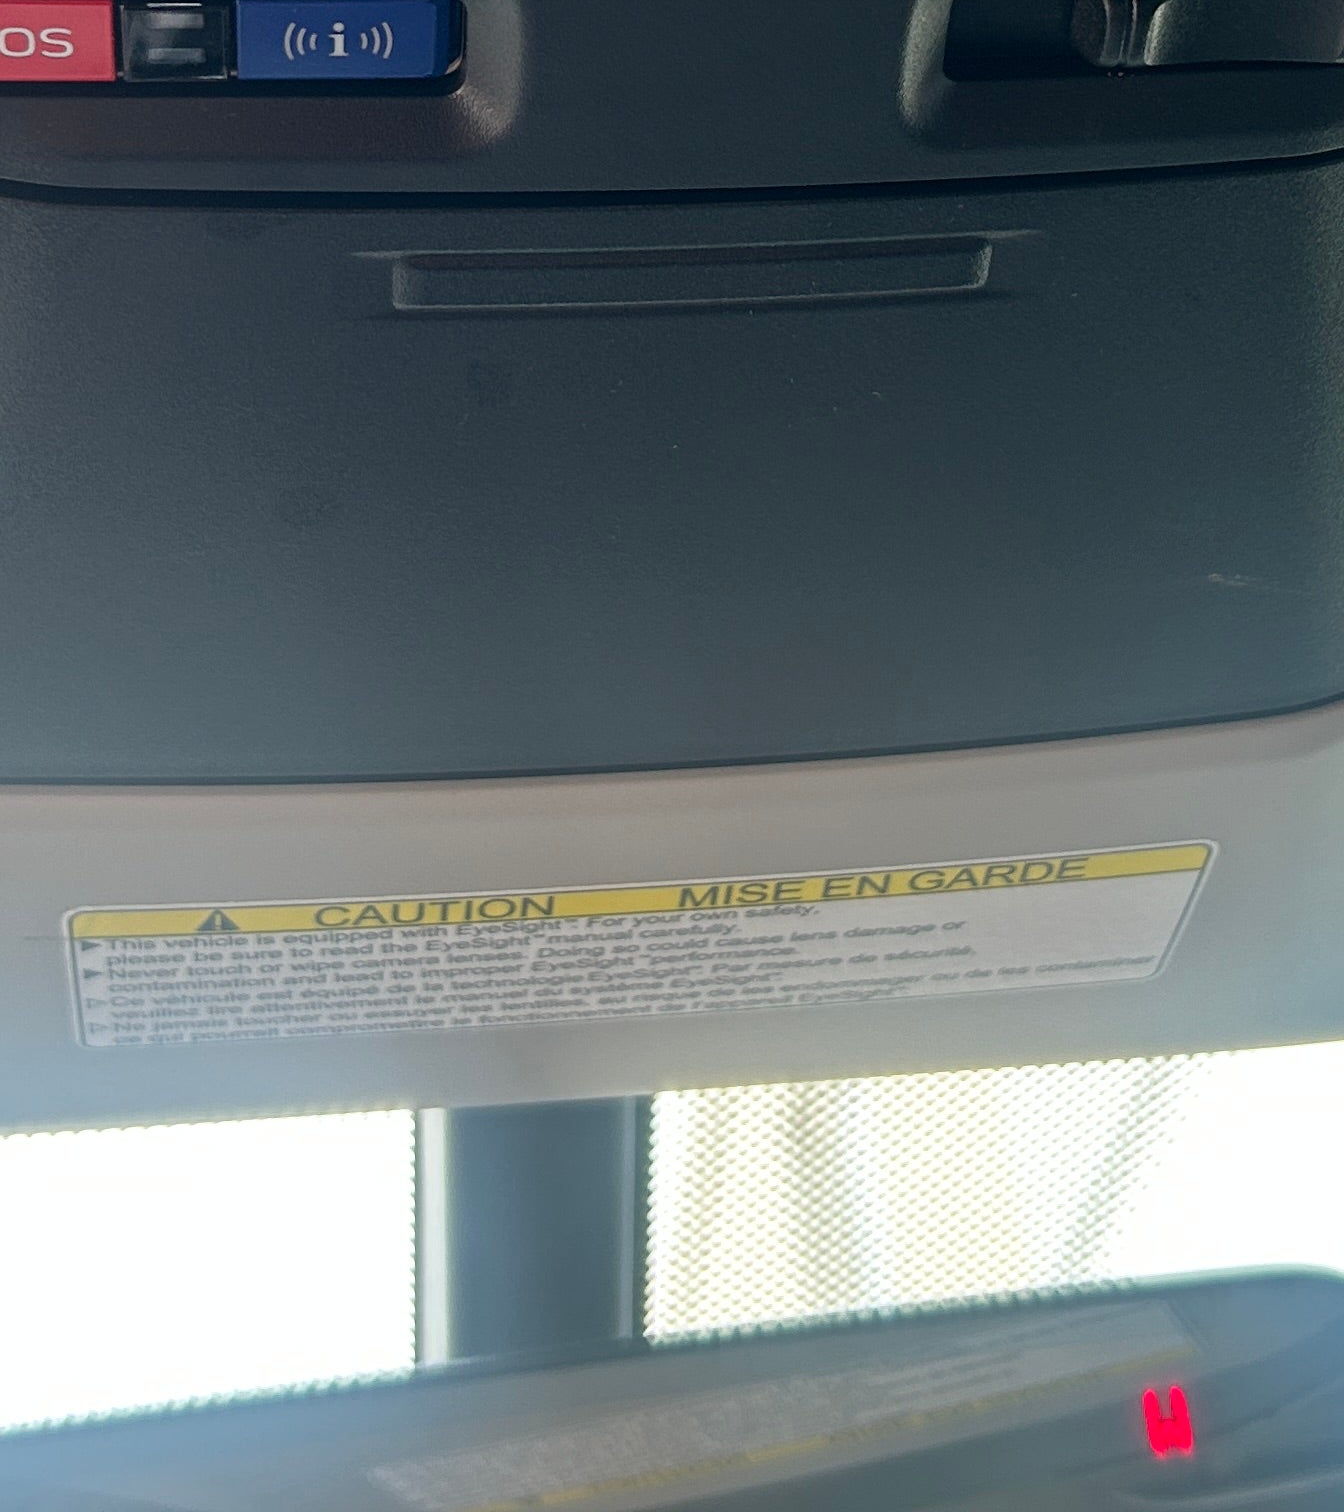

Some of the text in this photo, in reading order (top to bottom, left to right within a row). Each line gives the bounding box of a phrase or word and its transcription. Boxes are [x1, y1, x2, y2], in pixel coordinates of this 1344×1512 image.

[678, 857, 1089, 907] MISE EN GARDE
[105, 936, 155, 950] This
[164, 934, 247, 949] vehicle
[256, 934, 274, 945] is
[283, 928, 392, 946] equipped
[401, 925, 446, 937] with
[586, 914, 626, 926] For
[632, 913, 684, 926] your
[690, 909, 738, 921] own
[744, 903, 820, 918] safety.
[314, 895, 555, 926] CAUTION
[106, 951, 185, 966] please
[194, 949, 222, 961] be
[231, 949, 282, 960] sure
[290, 946, 312, 957] to
[320, 943, 373, 955] read
[380, 941, 417, 953] the
[546, 929, 632, 943] manual
[639, 923, 741, 938] carefully.
[108, 964, 178, 980] Never
[186, 963, 250, 976] touch
[259, 963, 282, 972] or
[290, 959, 344, 972] wipe
[351, 955, 439, 967] camera
[537, 944, 605, 959] Doing
[611, 943, 639, 953] so
[646, 938, 708, 950] could
[715, 935, 783, 946] cause
[790, 929, 837, 941] lens
[843, 923, 936, 938] damage
[941, 920, 967, 930] or
[109, 976, 274, 994] contamination
[282, 974, 326, 985] and
[334, 970, 384, 982] lead
[391, 969, 413, 978] to
[420, 963, 522, 978] improper
